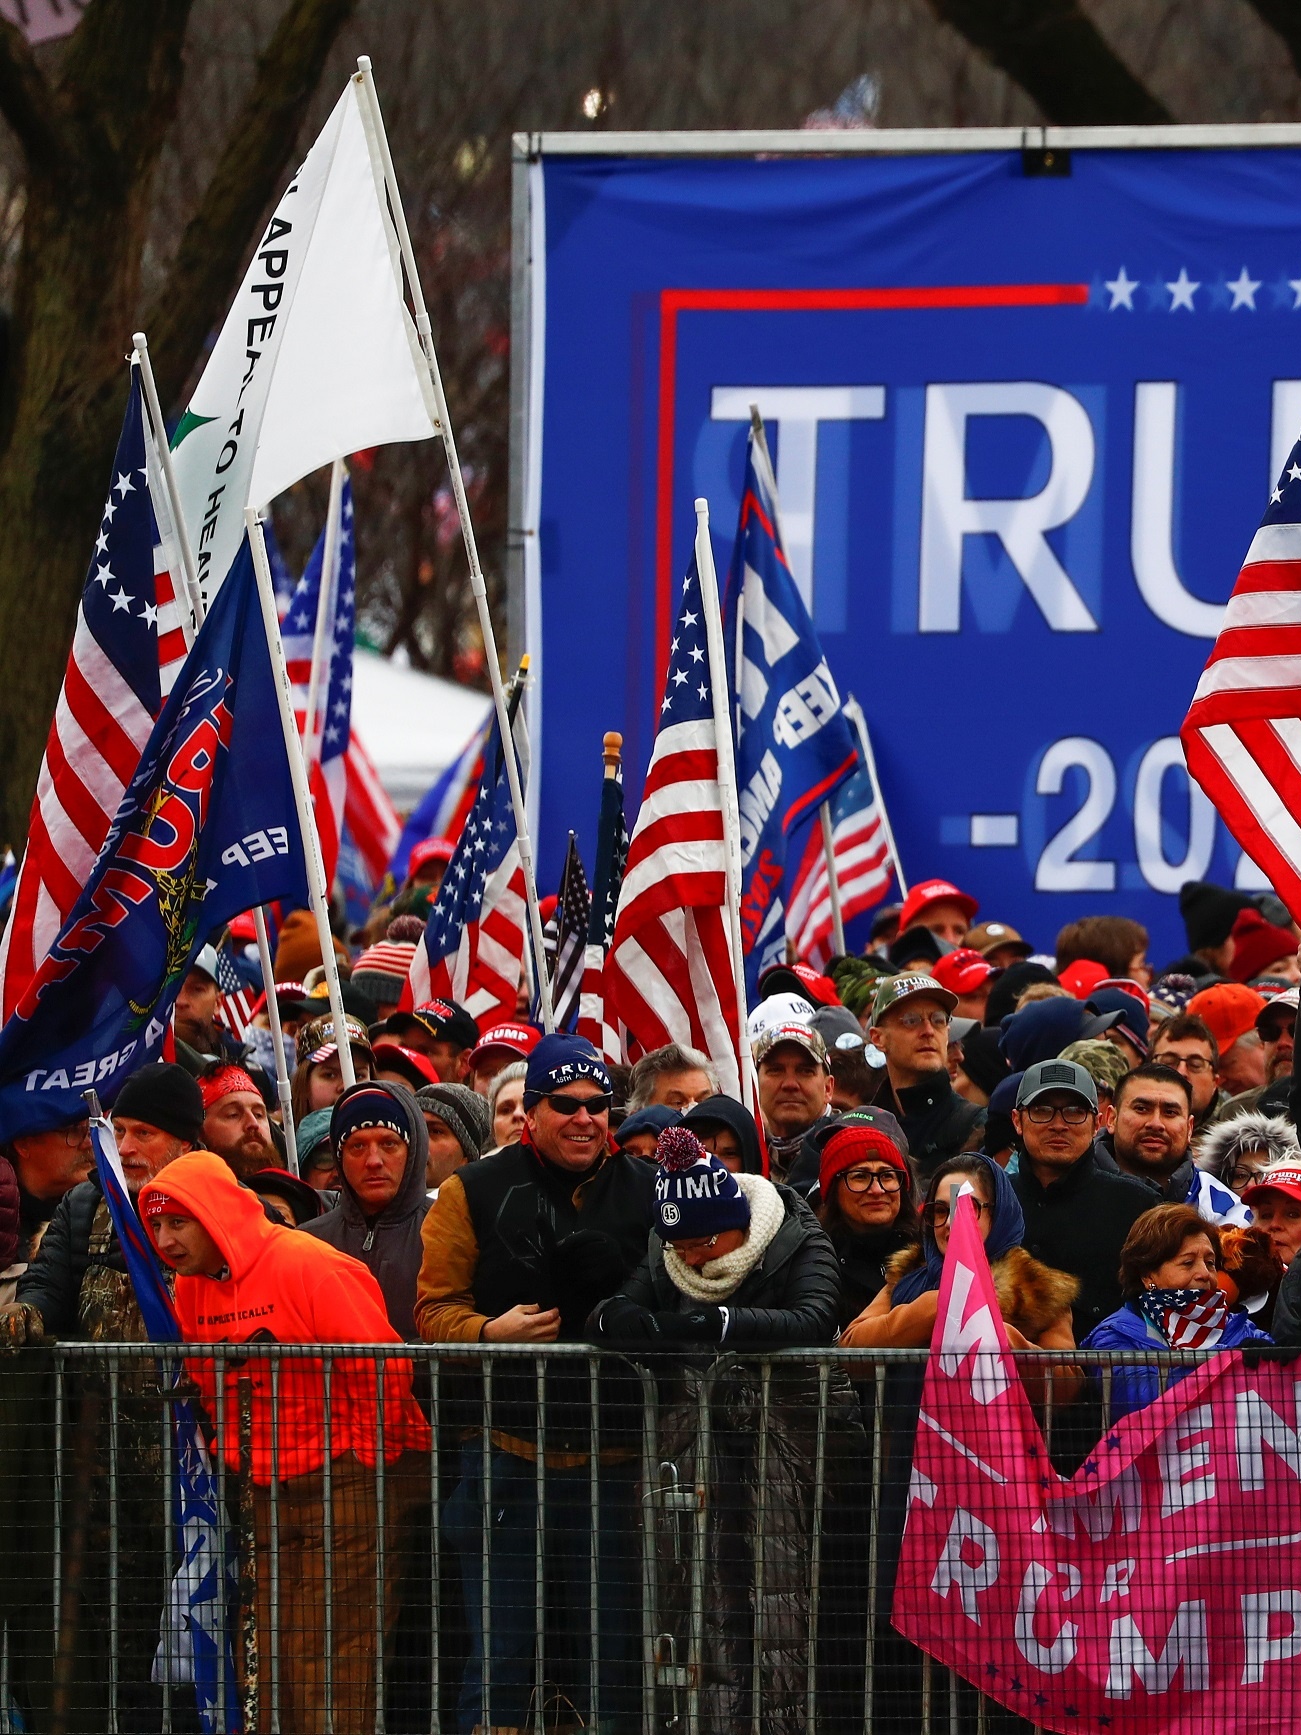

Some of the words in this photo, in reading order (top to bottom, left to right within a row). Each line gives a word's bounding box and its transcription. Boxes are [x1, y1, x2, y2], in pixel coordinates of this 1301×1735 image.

[275, 981, 311, 996] TRUM
[752, 1022, 766, 1034] 45
[478, 1028, 529, 1045] TRUMP
[548, 1063, 610, 1085] TRUMP
[664, 1207, 678, 1221] 45
